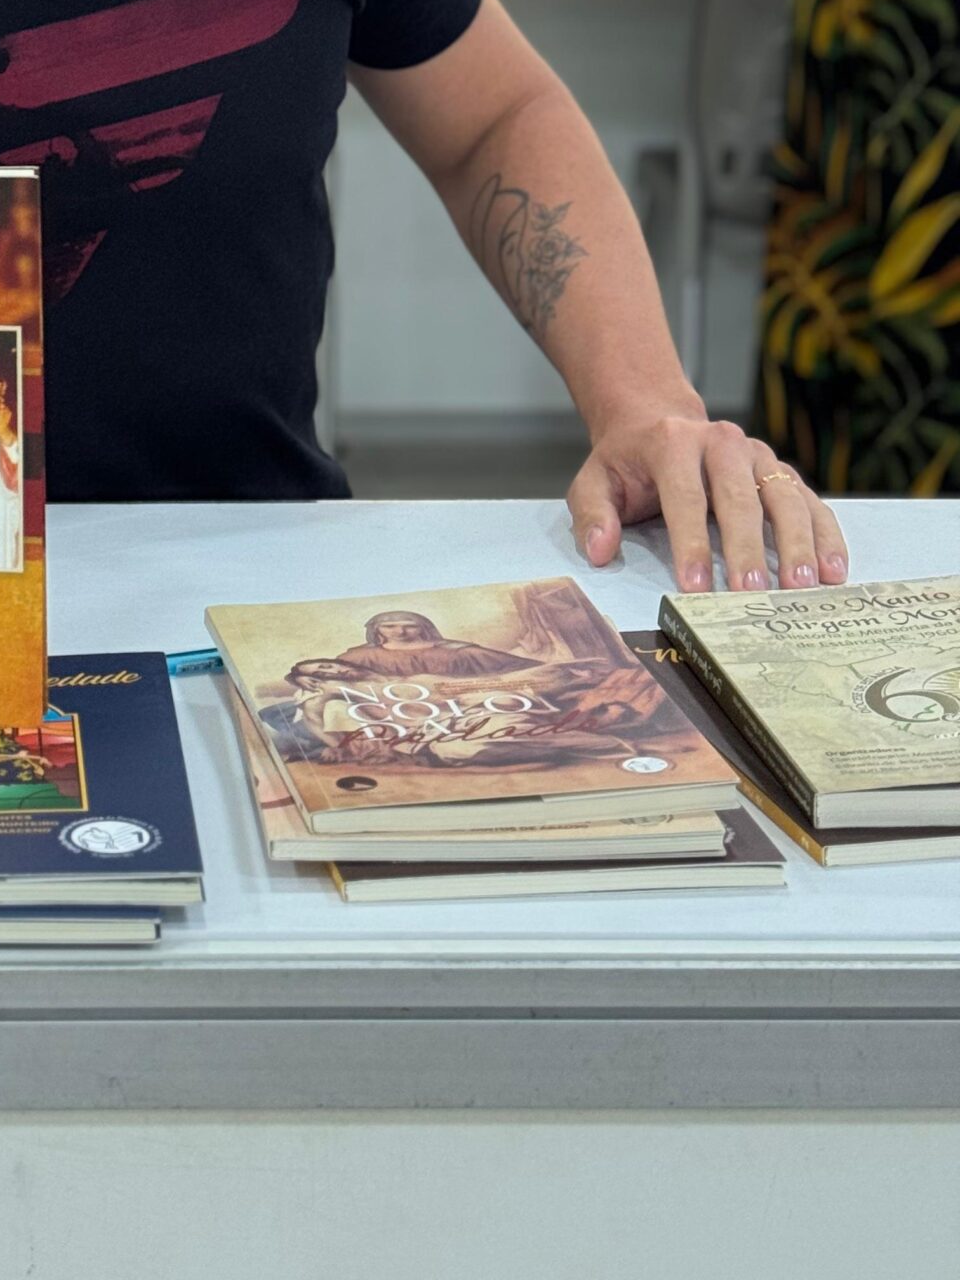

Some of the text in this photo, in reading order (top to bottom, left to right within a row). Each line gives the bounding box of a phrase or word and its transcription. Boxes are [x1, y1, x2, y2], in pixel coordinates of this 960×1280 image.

[743, 592, 951, 618] Sob o Manto
[752, 617, 882, 634] Virgem
[47, 670, 142, 688] edade
[338, 683, 431, 705] NO
[347, 693, 533, 722] COLO
